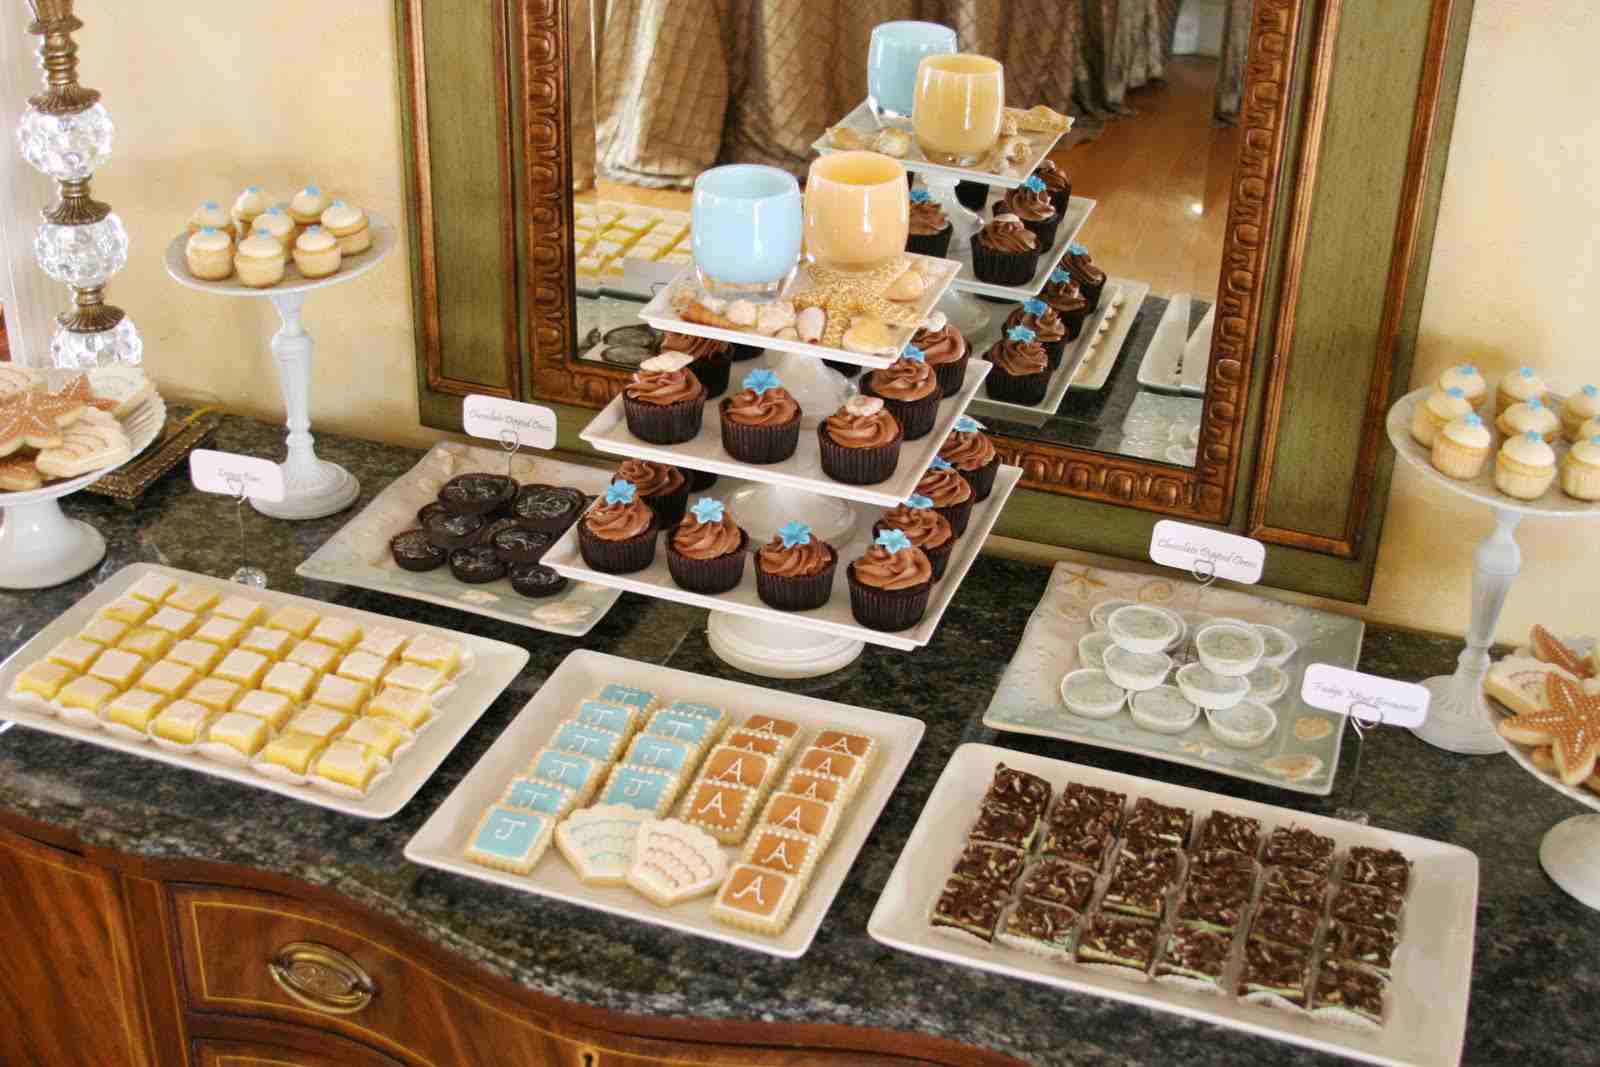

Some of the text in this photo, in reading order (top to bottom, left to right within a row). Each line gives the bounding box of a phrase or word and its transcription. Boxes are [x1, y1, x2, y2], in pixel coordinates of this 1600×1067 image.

[712, 757, 743, 783] A
[697, 791, 727, 818] A
[772, 805, 803, 833] A
[760, 840, 794, 870] A
[732, 874, 765, 905] A
